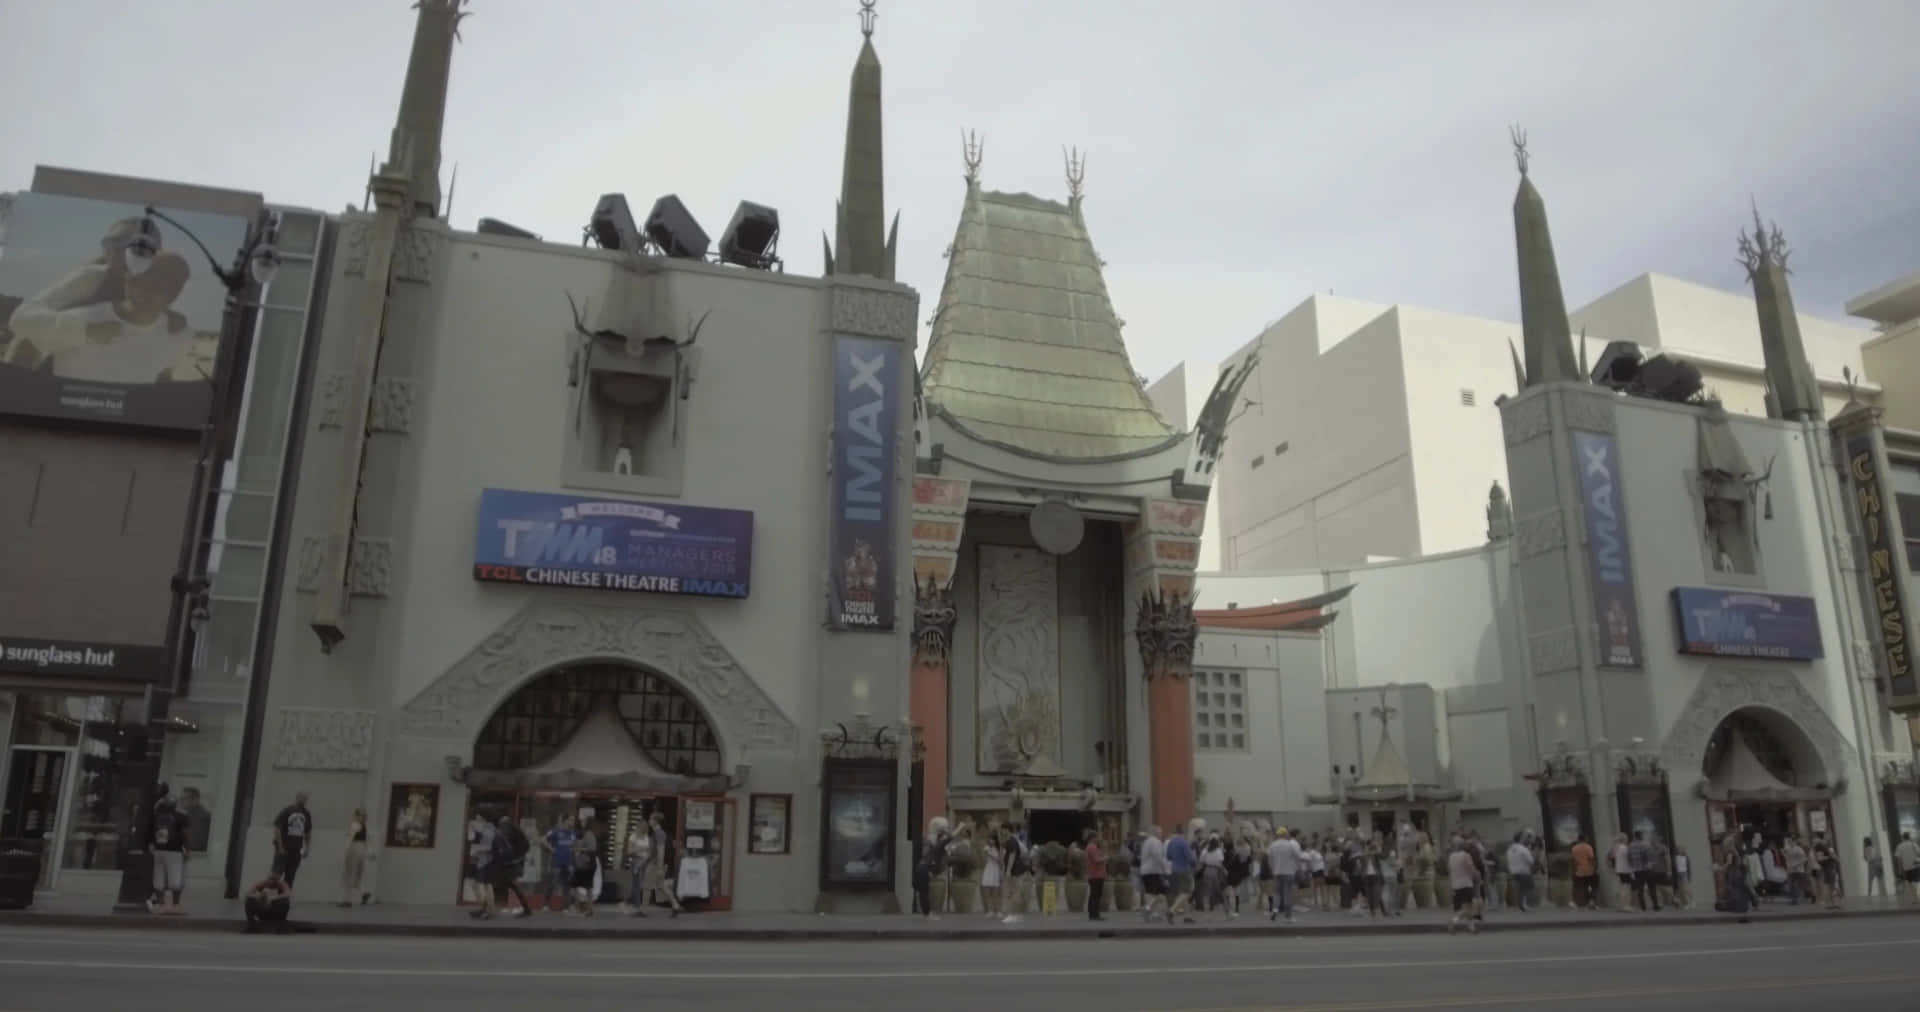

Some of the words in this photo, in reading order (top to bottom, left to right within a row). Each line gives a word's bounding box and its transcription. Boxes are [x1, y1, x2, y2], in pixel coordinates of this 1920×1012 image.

[844, 353, 885, 520] IMAX
[1584, 444, 1624, 583] IMAX
[478, 565, 523, 581] TCL
[526, 567, 600, 587] CHINESE
[604, 573, 680, 593] THEATRE
[682, 581, 746, 597] IMAX
[1852, 453, 1907, 678] CHINESE
[7, 644, 82, 667] sunglass
[85, 647, 115, 667] hut
[841, 613, 880, 625] IMAX
